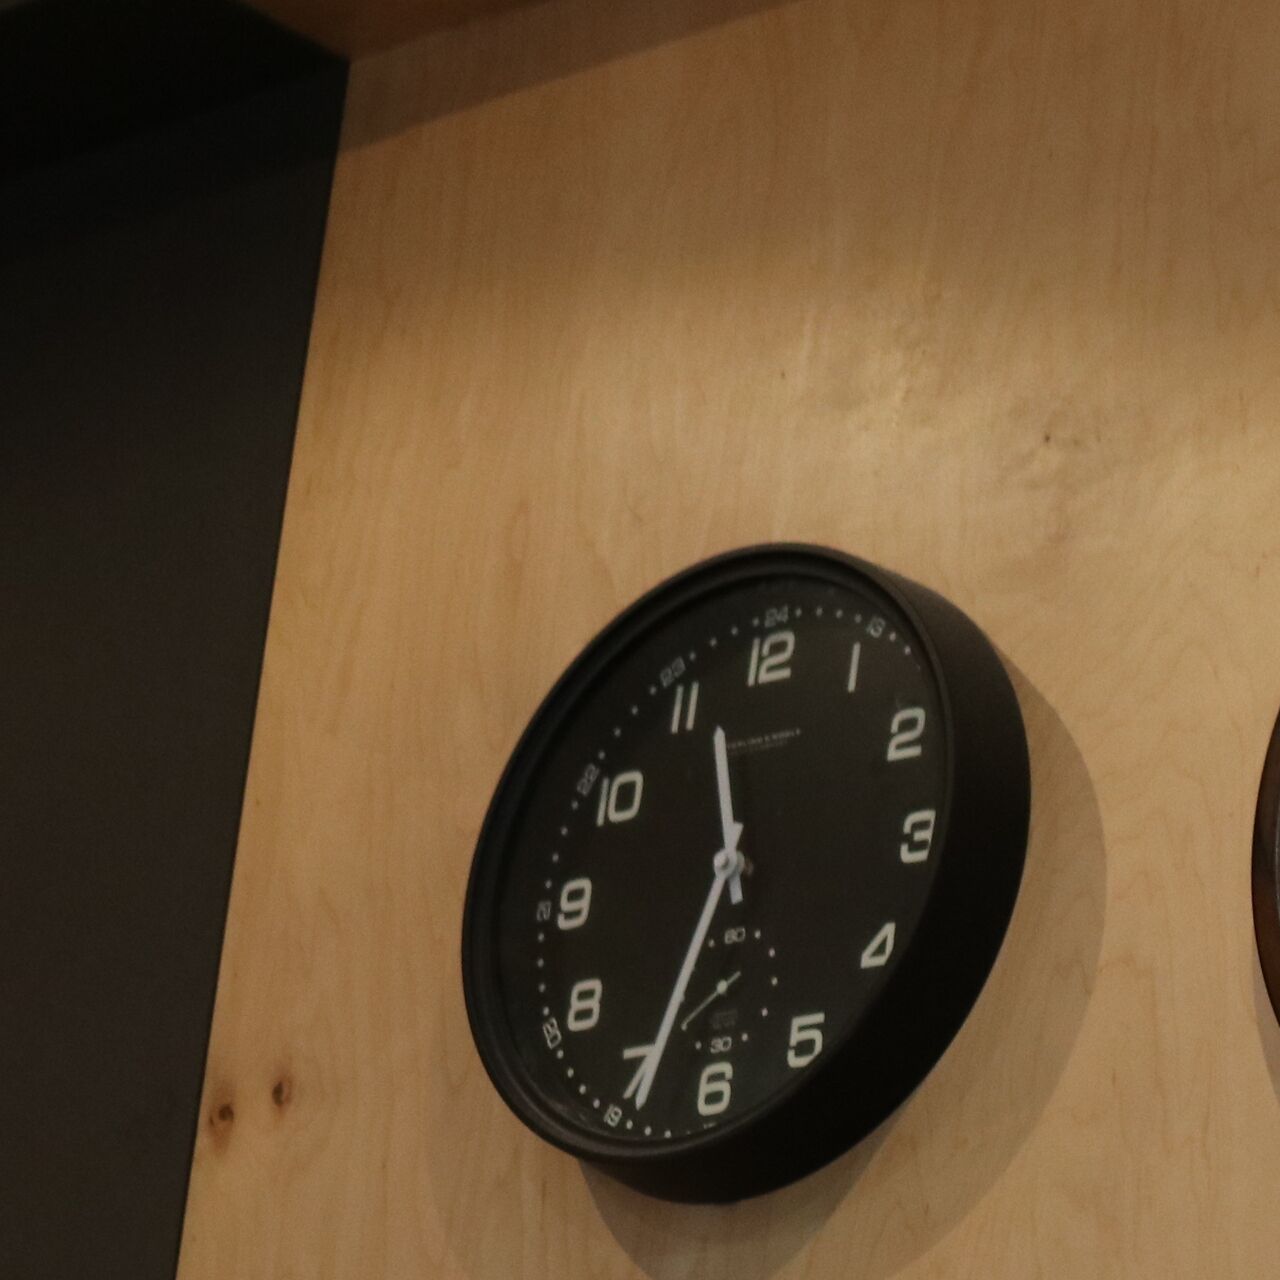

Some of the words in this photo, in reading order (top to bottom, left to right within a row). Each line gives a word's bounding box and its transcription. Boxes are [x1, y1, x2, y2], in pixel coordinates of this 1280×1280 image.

[746, 630, 796, 688] 12
[845, 640, 862, 693] 1
[669, 681, 700, 735] 11
[884, 705, 927, 763] 2
[596, 769, 645, 828] 10
[898, 808, 937, 864] 3
[555, 876, 592, 931] 9
[859, 919, 897, 970] 4
[566, 977, 604, 1032] 8
[708, 1036, 733, 1055] 30
[785, 1010, 826, 1071] 5
[696, 1060, 734, 1118] 6
